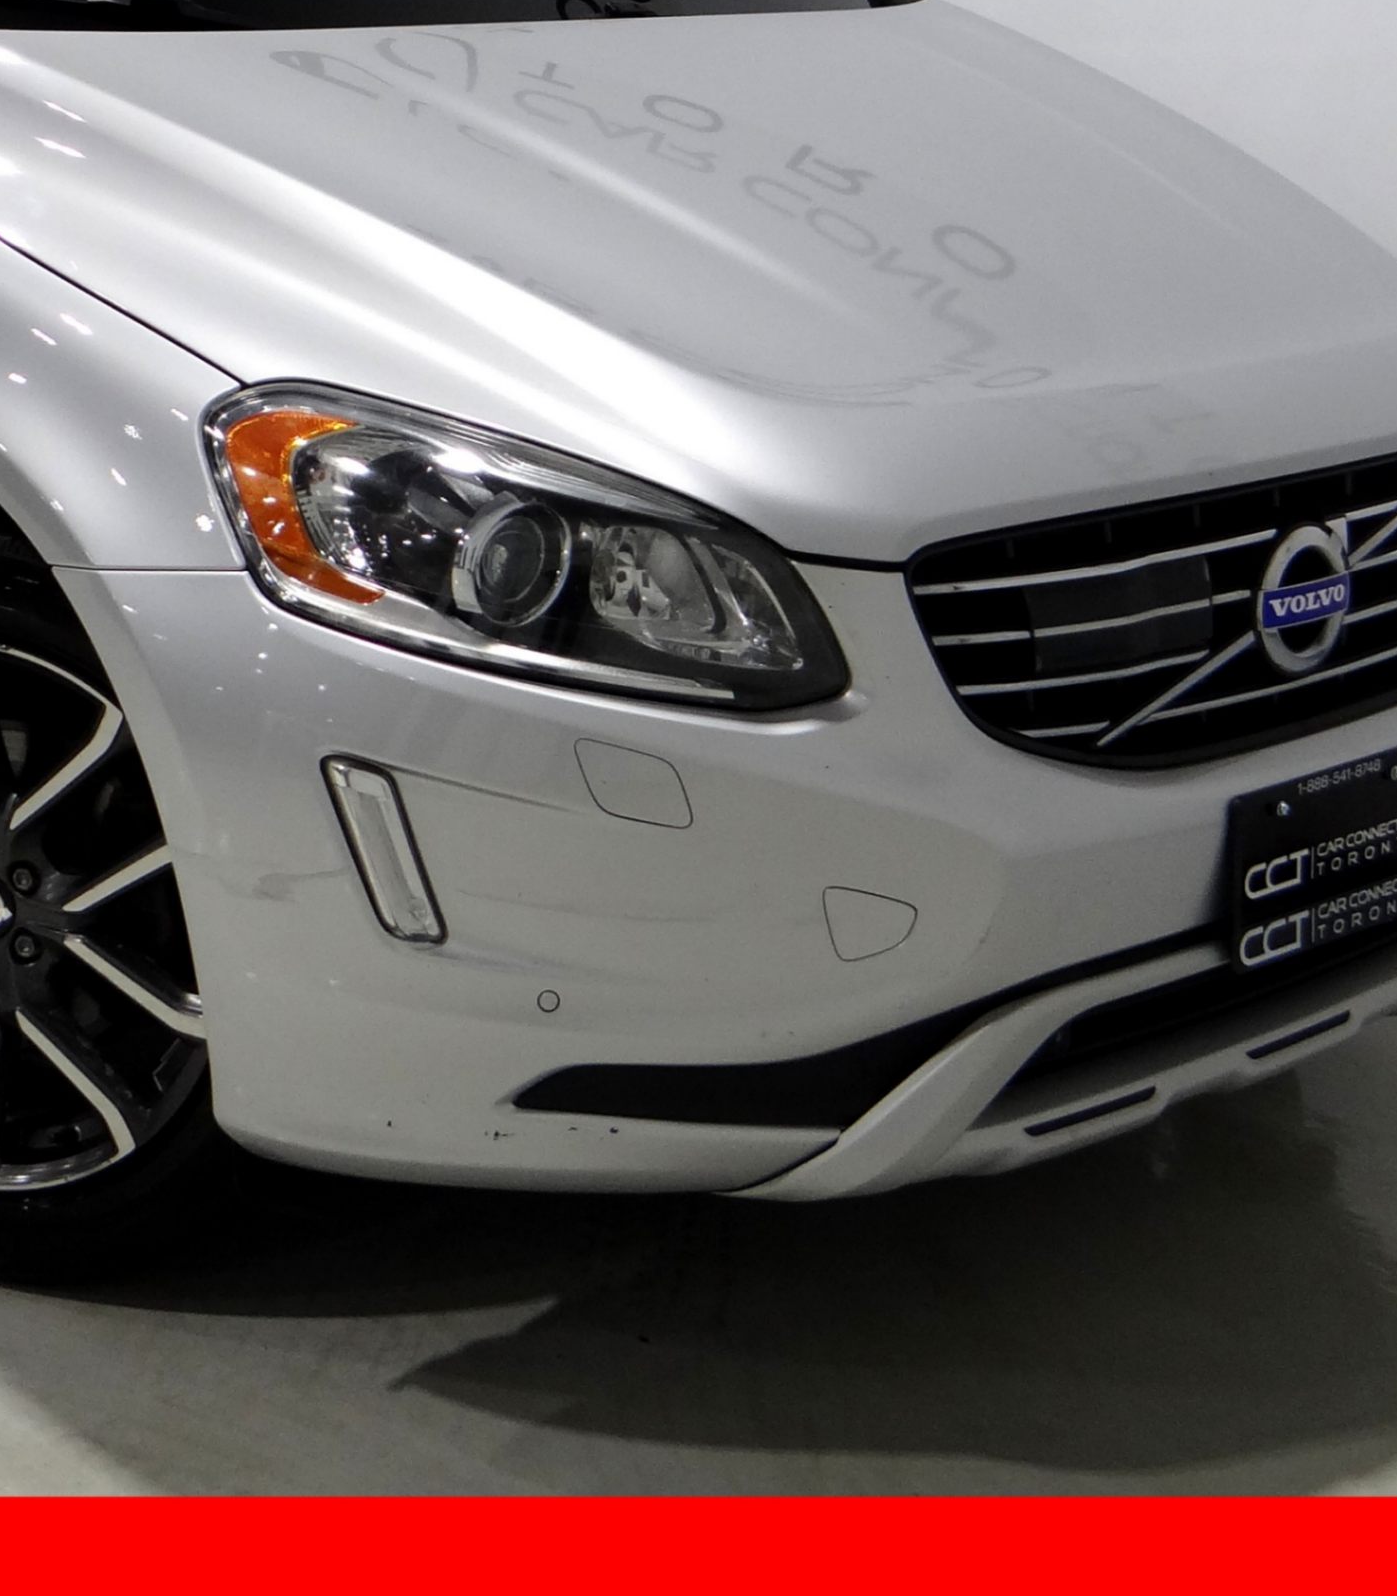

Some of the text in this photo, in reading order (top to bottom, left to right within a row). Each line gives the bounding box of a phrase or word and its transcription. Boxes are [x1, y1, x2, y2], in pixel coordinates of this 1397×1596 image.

[1269, 584, 1345, 617] VOLVO
[1298, 759, 1381, 795] 1-888-541-8748
[1316, 837, 1345, 858] CAR
[1244, 848, 1310, 900] CCT
[1317, 899, 1347, 920] CAR
[1239, 910, 1310, 967] CCT
